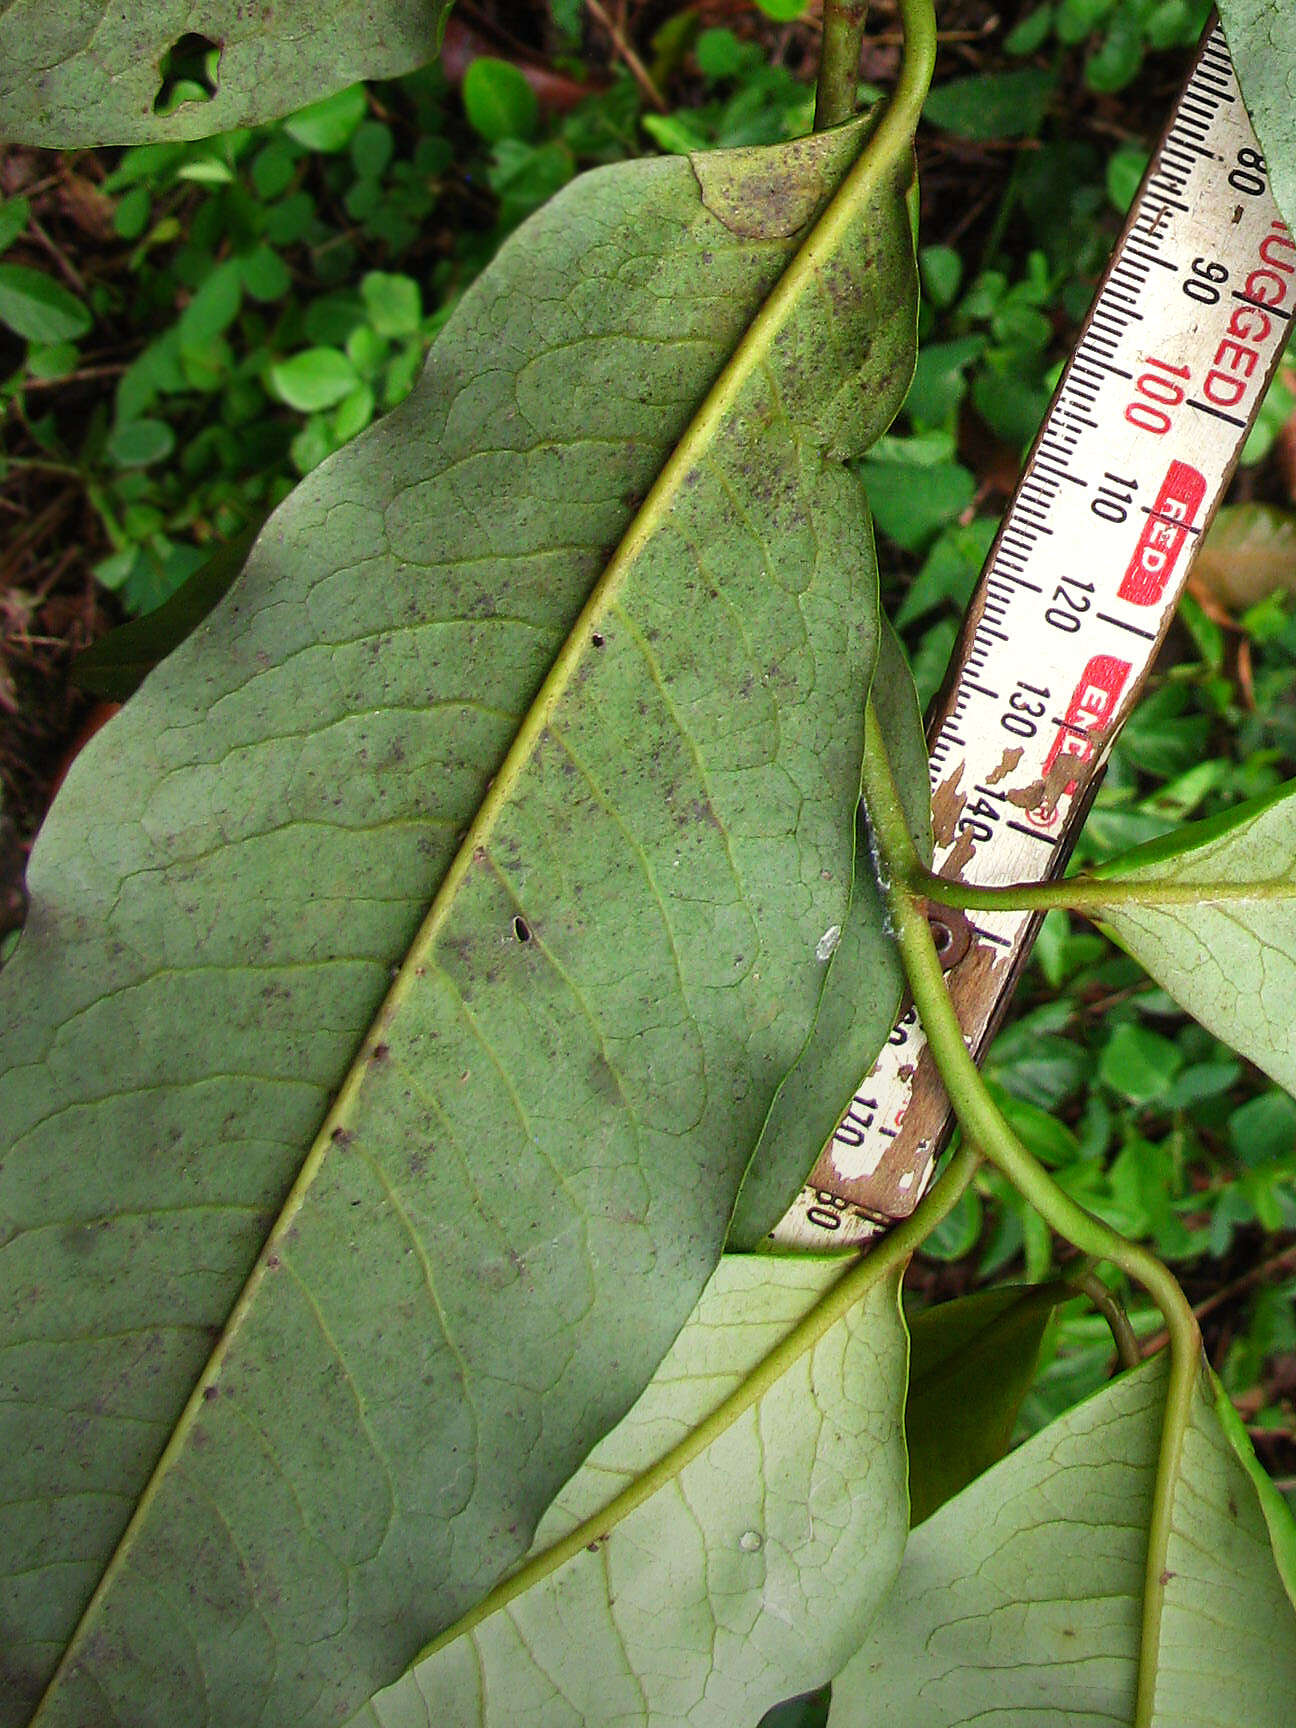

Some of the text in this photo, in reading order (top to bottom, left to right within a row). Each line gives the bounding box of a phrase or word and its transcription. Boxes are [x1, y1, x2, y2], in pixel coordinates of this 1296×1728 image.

[1203, 221, 1296, 407] UGGED
[958, 147, 1267, 843] 80 90 100 110 120 130 140
[1140, 497, 1188, 572] RED
